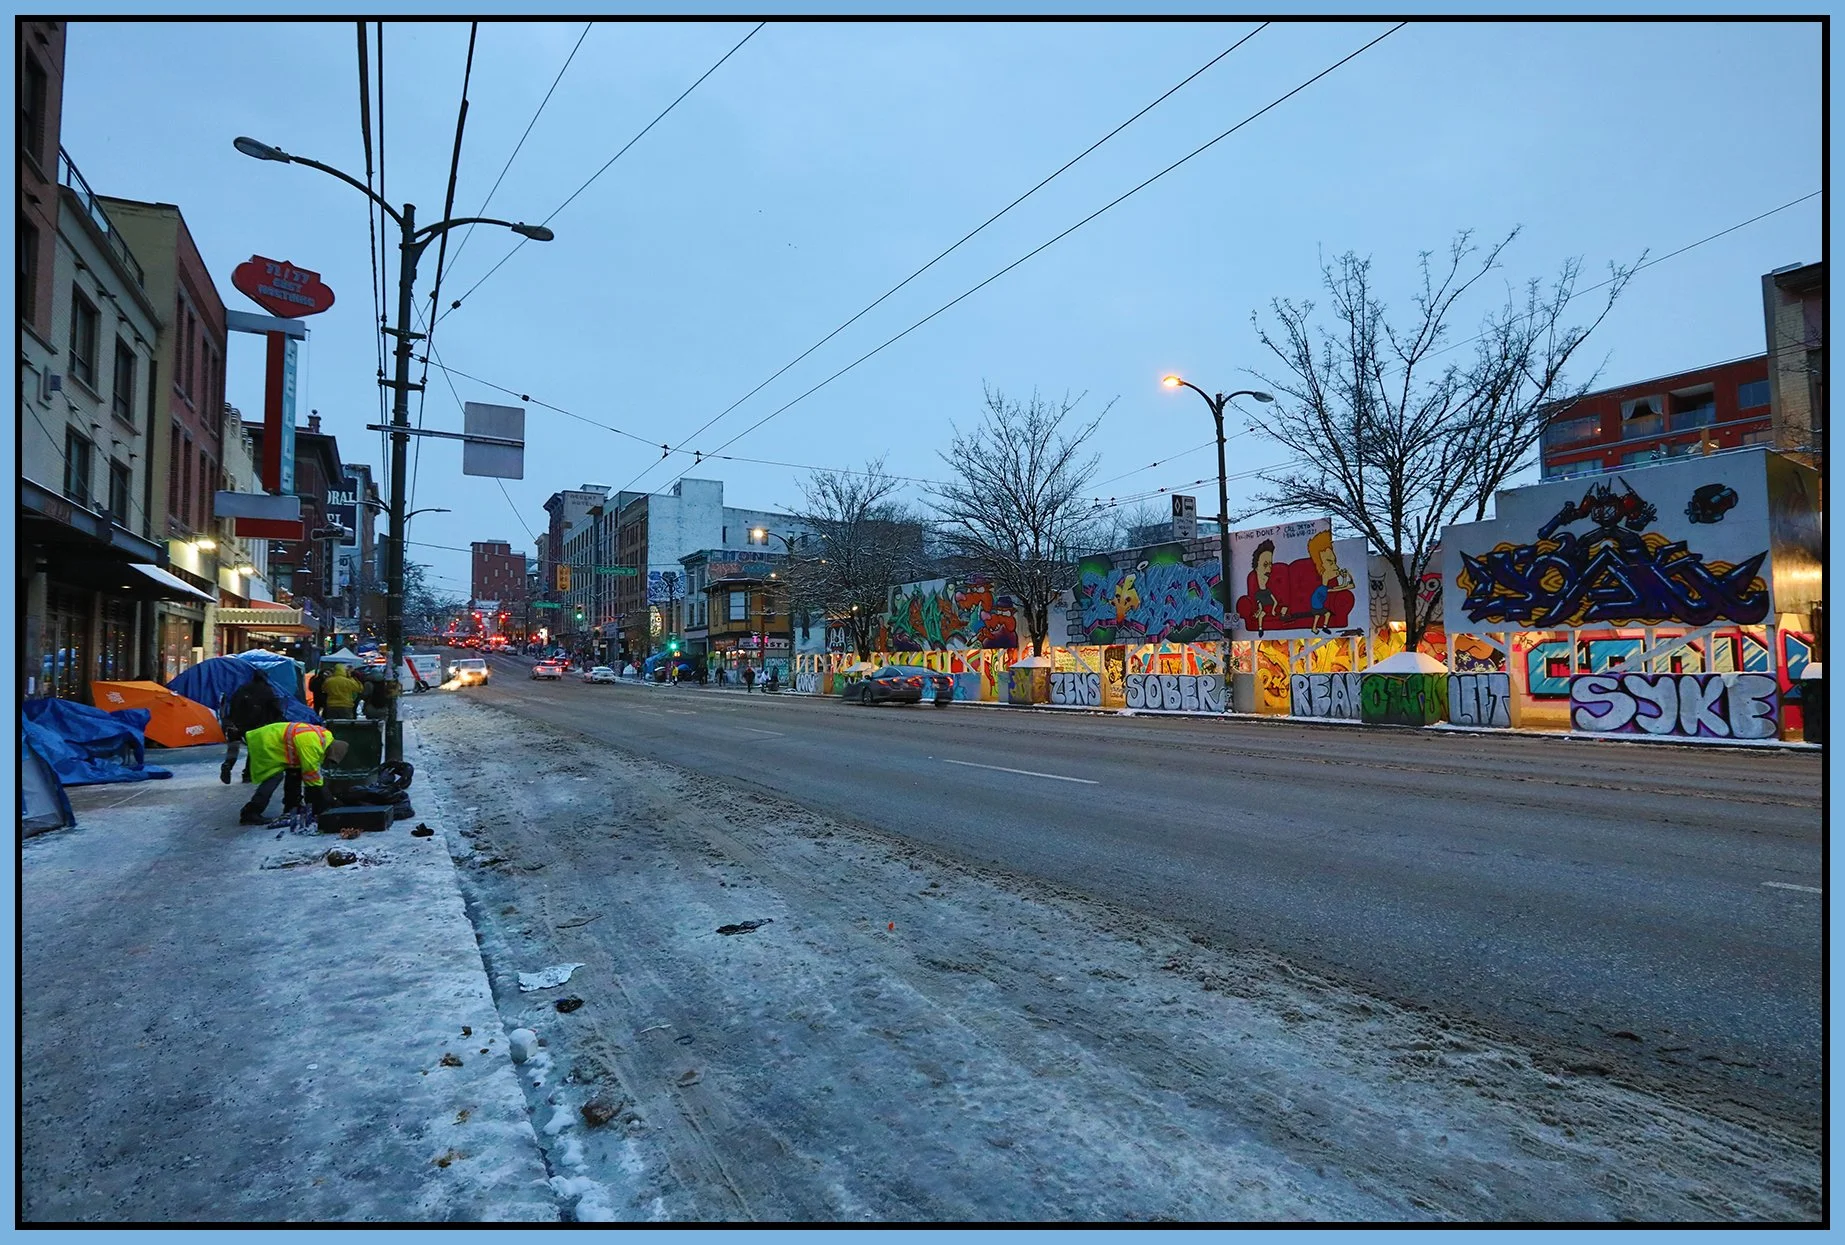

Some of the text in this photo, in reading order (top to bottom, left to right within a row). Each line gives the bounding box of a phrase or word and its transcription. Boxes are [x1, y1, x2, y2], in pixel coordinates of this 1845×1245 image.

[1050, 672, 1101, 706] ZENS
[1125, 674, 1226, 712] SOBER
[1570, 674, 1777, 740] SYKE
